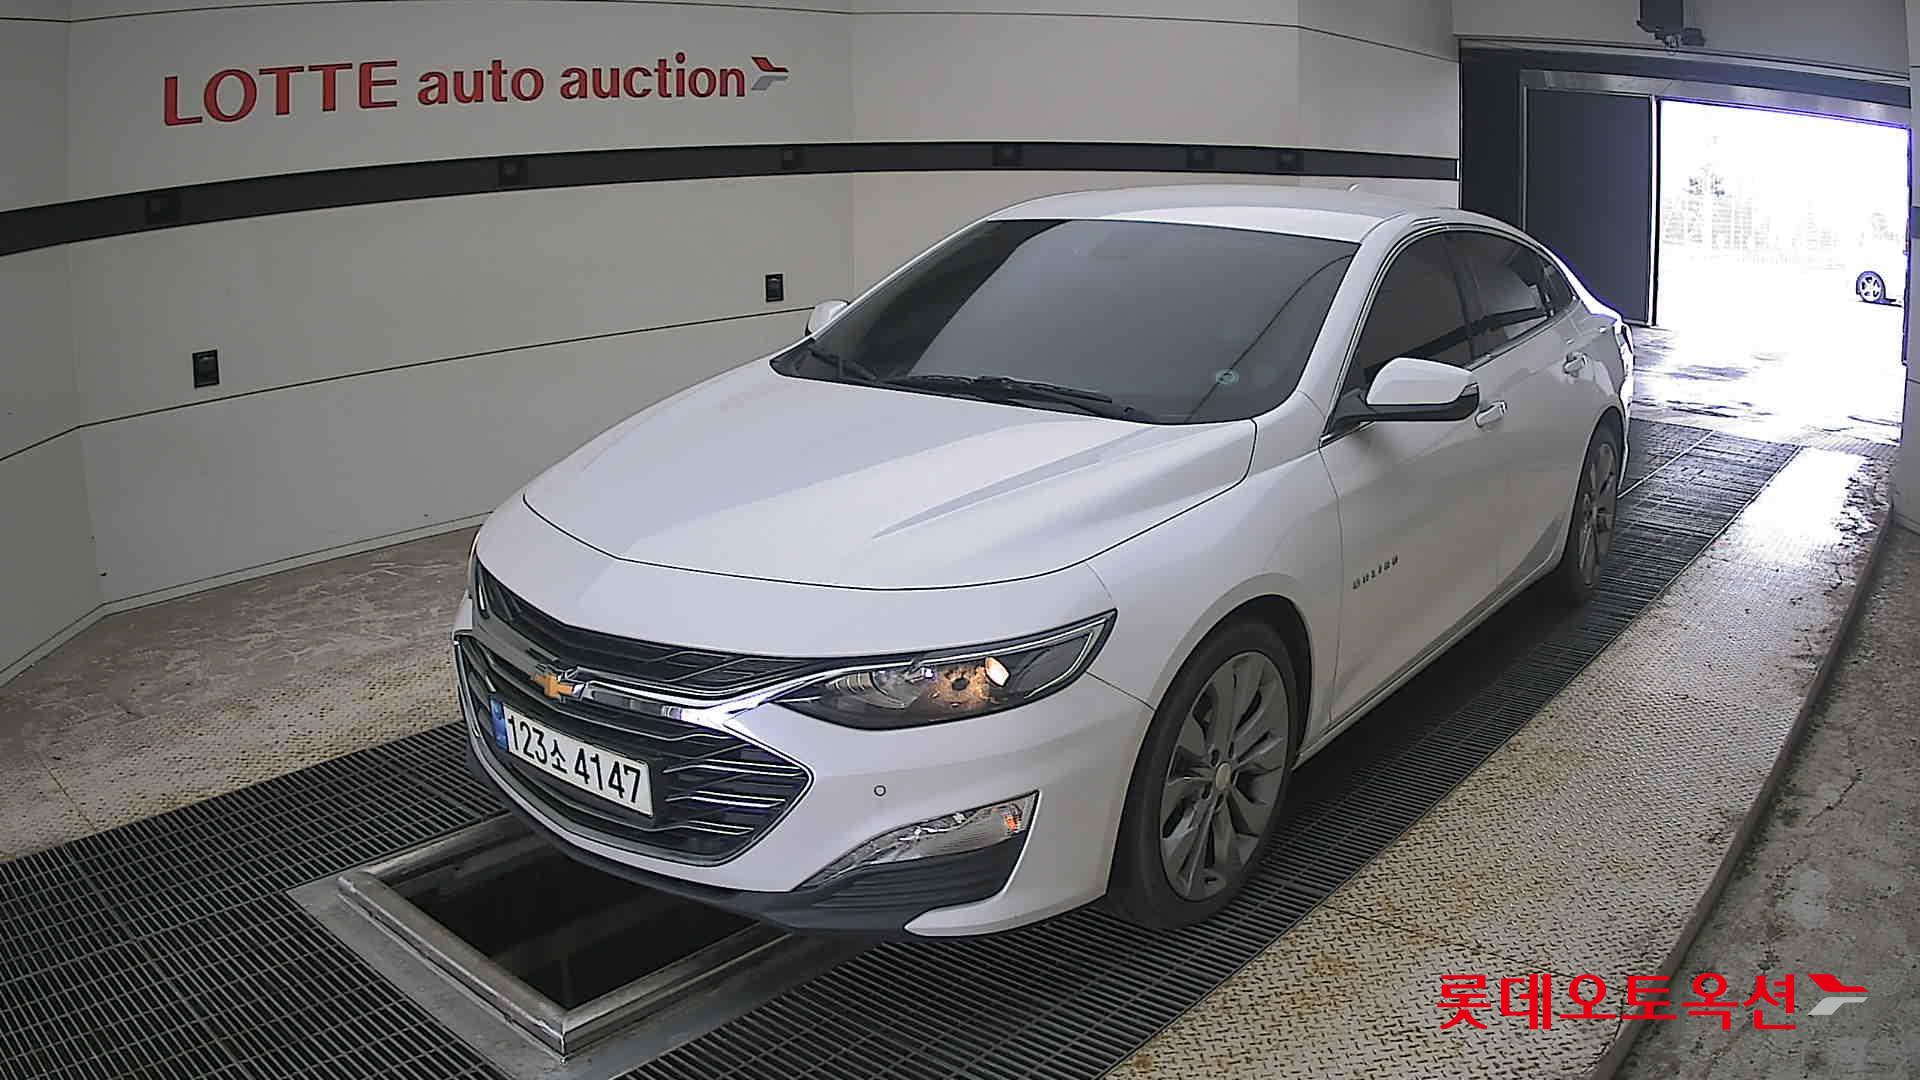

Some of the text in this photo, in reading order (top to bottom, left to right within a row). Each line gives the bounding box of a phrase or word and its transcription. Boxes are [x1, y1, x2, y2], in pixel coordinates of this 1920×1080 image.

[164, 52, 746, 126] LOTTE auto auction
[574, 748, 641, 803] 4147
